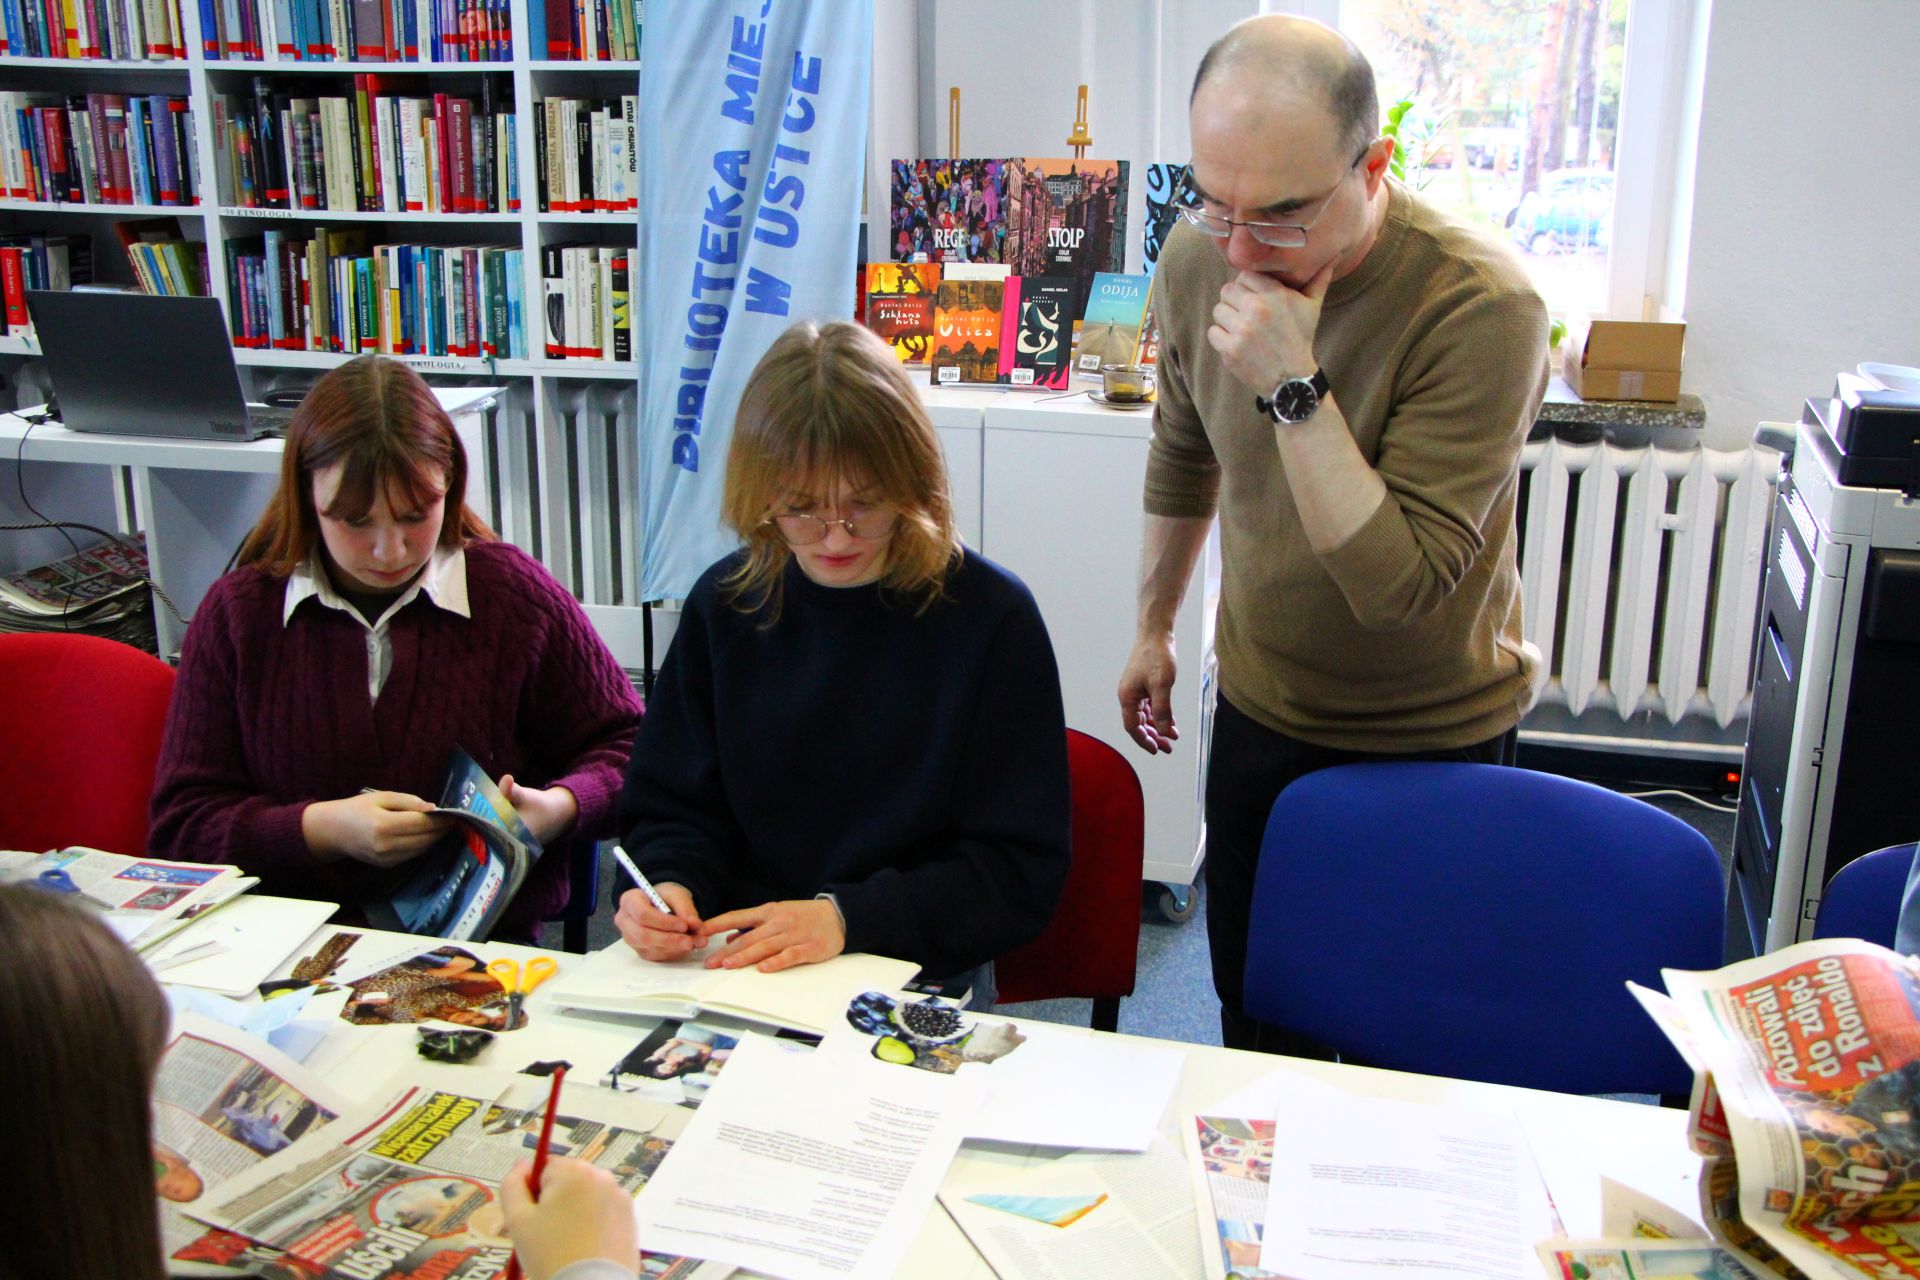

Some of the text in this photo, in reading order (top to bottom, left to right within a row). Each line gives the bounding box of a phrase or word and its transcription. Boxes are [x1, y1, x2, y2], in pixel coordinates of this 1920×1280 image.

[626, 100, 637, 173] ATLAS CHWASTÓW
[237, 209, 293, 218] ETNOLOGIA
[745, 267, 792, 317] W
[1101, 284, 1139, 298] ODIJA
[880, 309, 921, 319] Szklana
[896, 317, 920, 325] huta
[939, 324, 993, 337] Ulica
[1780, 974, 1841, 1080] do zdjęć
[1817, 957, 1885, 1079] z Ronaldo
[1745, 983, 1808, 1086] Pozowali
